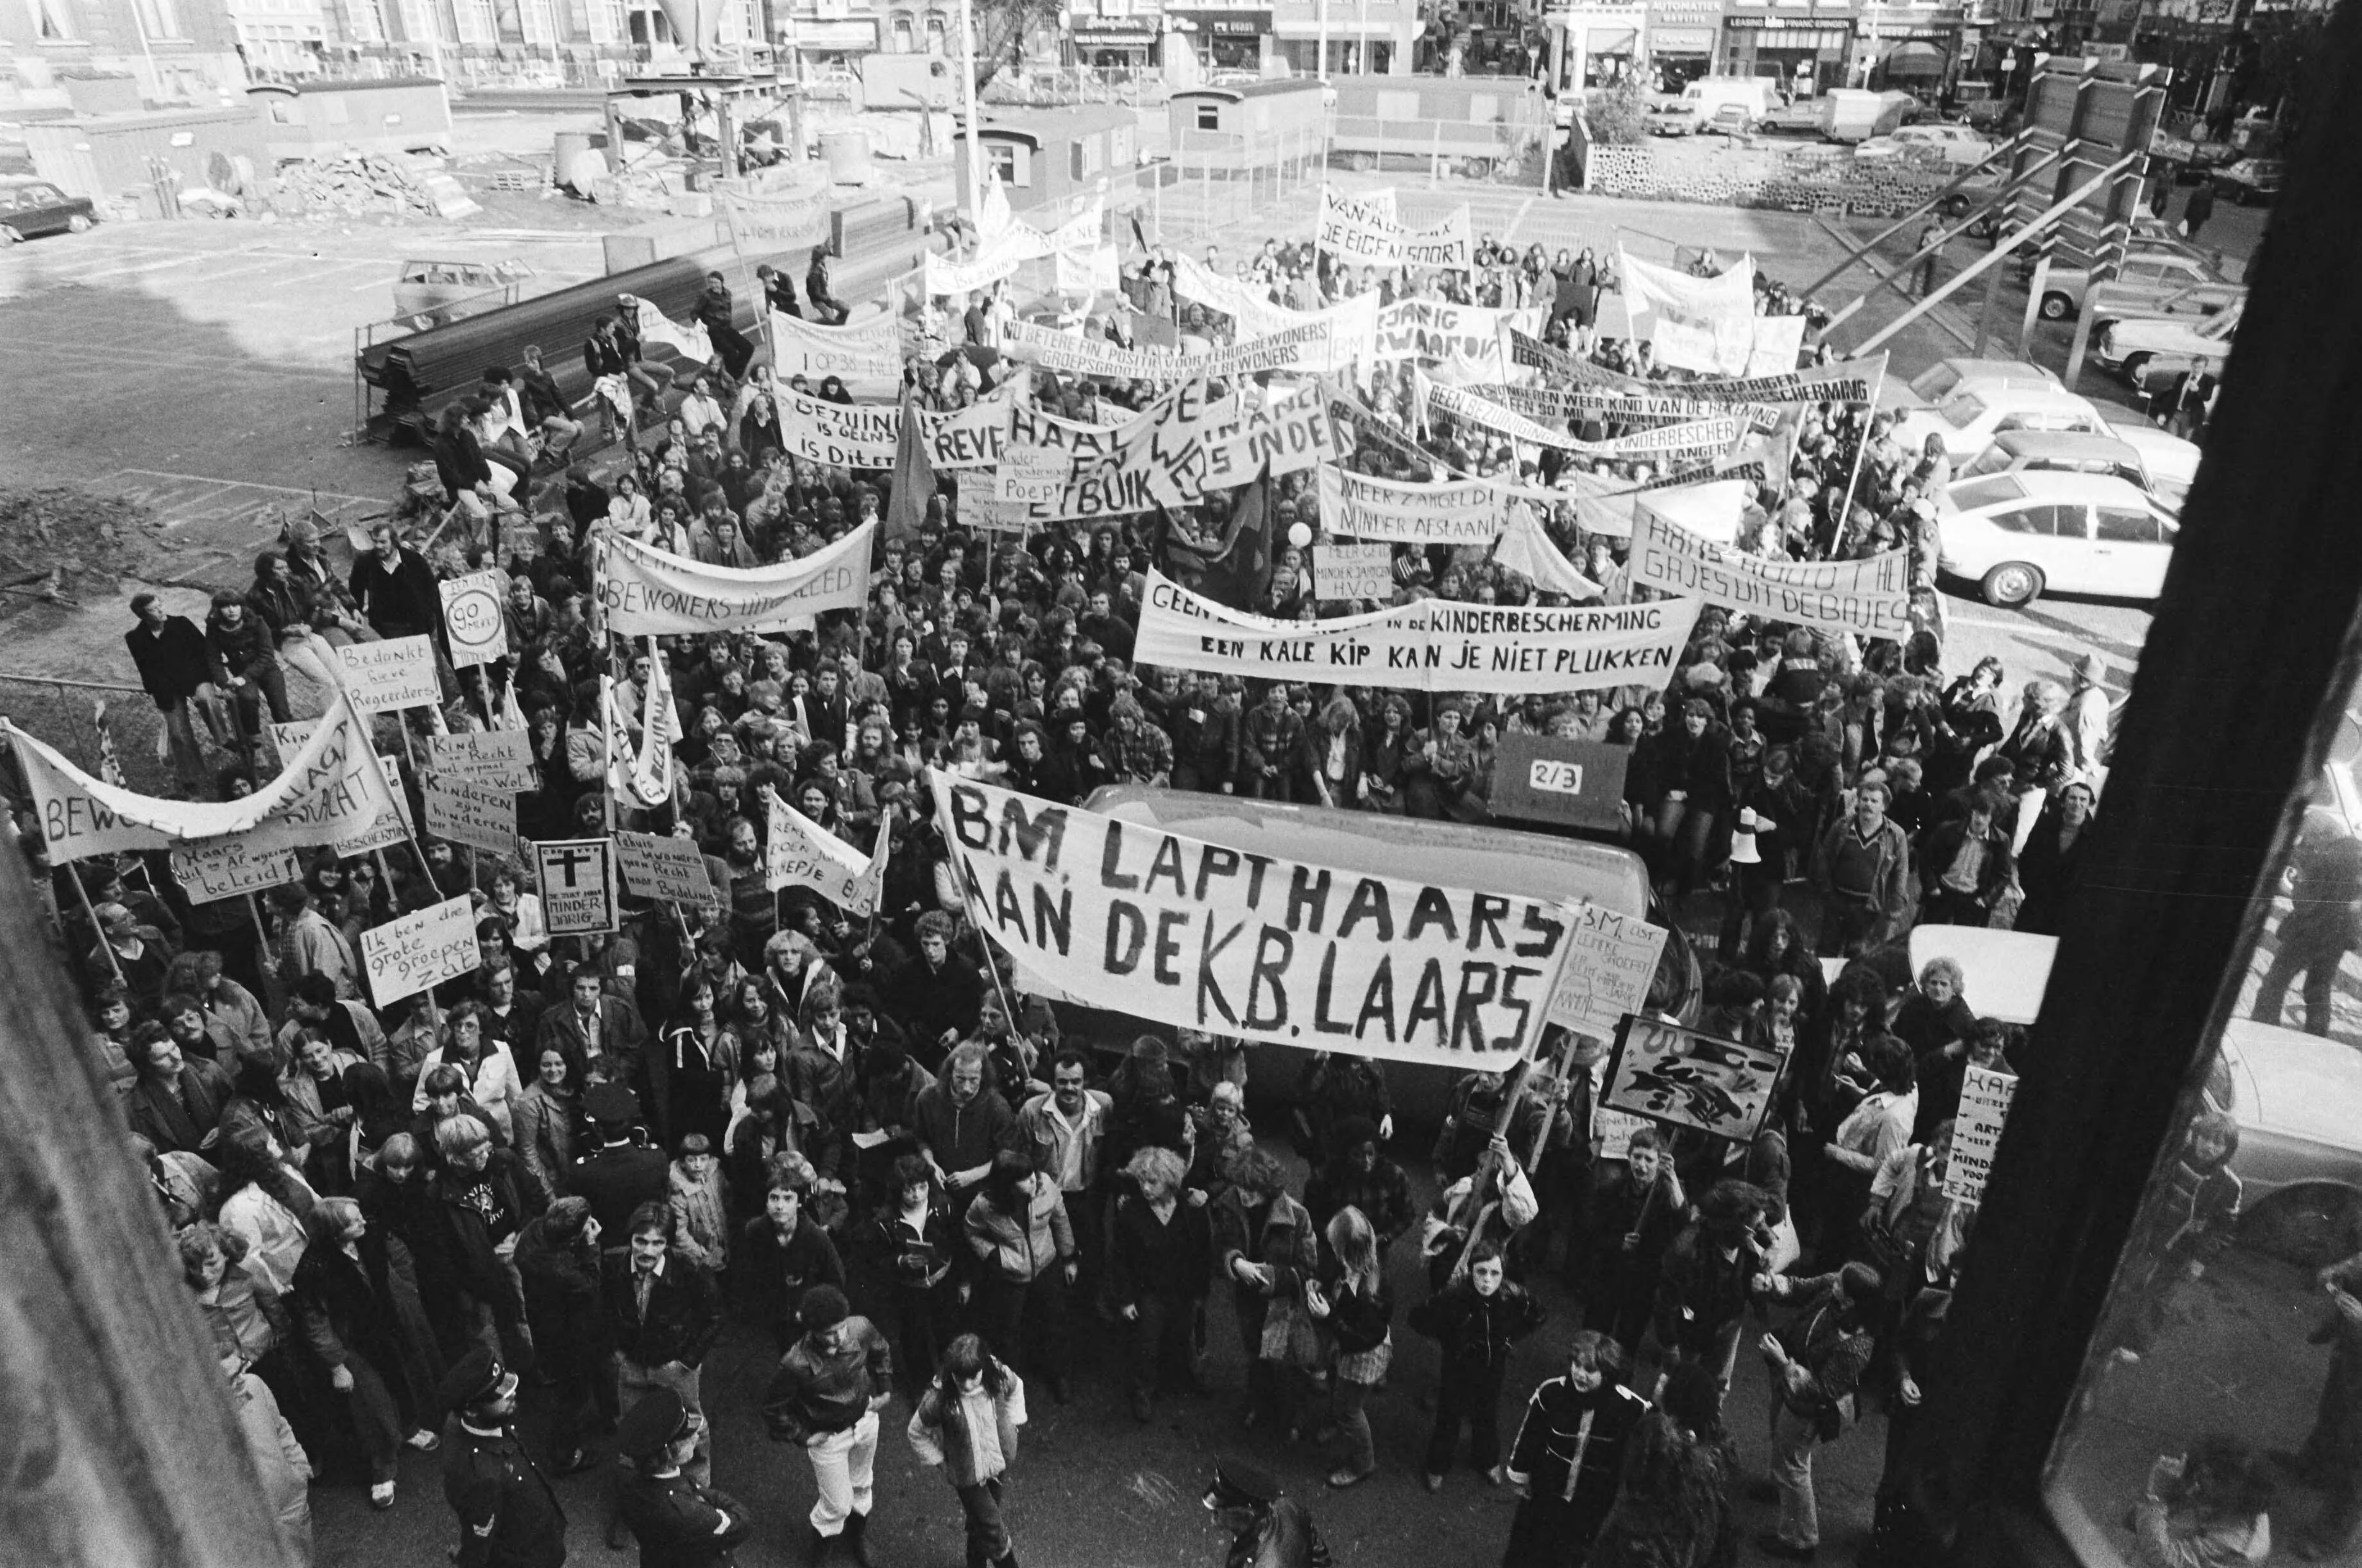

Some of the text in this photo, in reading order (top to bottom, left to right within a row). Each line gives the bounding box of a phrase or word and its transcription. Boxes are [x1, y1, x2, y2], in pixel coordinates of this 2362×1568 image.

[1327, 194, 1365, 222] VAN
[1003, 321, 1022, 340] NU
[1026, 326, 1075, 352] BETERE
[1221, 345, 1299, 375] BEWONERS
[1430, 384, 1465, 412] GEEN
[1564, 393, 1603, 409] WEER
[1609, 398, 1643, 413] KIND
[1649, 400, 1683, 414] VAN
[1341, 478, 1395, 505] MEER
[1645, 549, 1728, 597] GAJES
[1735, 578, 1771, 607] UIT
[1781, 589, 1815, 618] DE
[606, 578, 731, 620] BEWONERS
[1387, 619, 1402, 629] IN
[1409, 620, 1425, 631] DE
[1431, 609, 1661, 634] KINDERBESCHERMING
[1201, 636, 1244, 659] EEN
[1260, 641, 1316, 662] KALE
[1330, 637, 1371, 666] KIP
[1388, 644, 1441, 669] KAN
[1491, 641, 1548, 672] NIET
[1553, 645, 1673, 674] PLUKKEN
[549, 897, 601, 913] MINDER
[962, 854, 1073, 957] AAN
[1104, 899, 1189, 986] DE
[1286, 865, 1564, 958] HAARS
[394, 920, 424, 939] ben
[371, 938, 425, 977] grote
[398, 936, 474, 982] groepen
